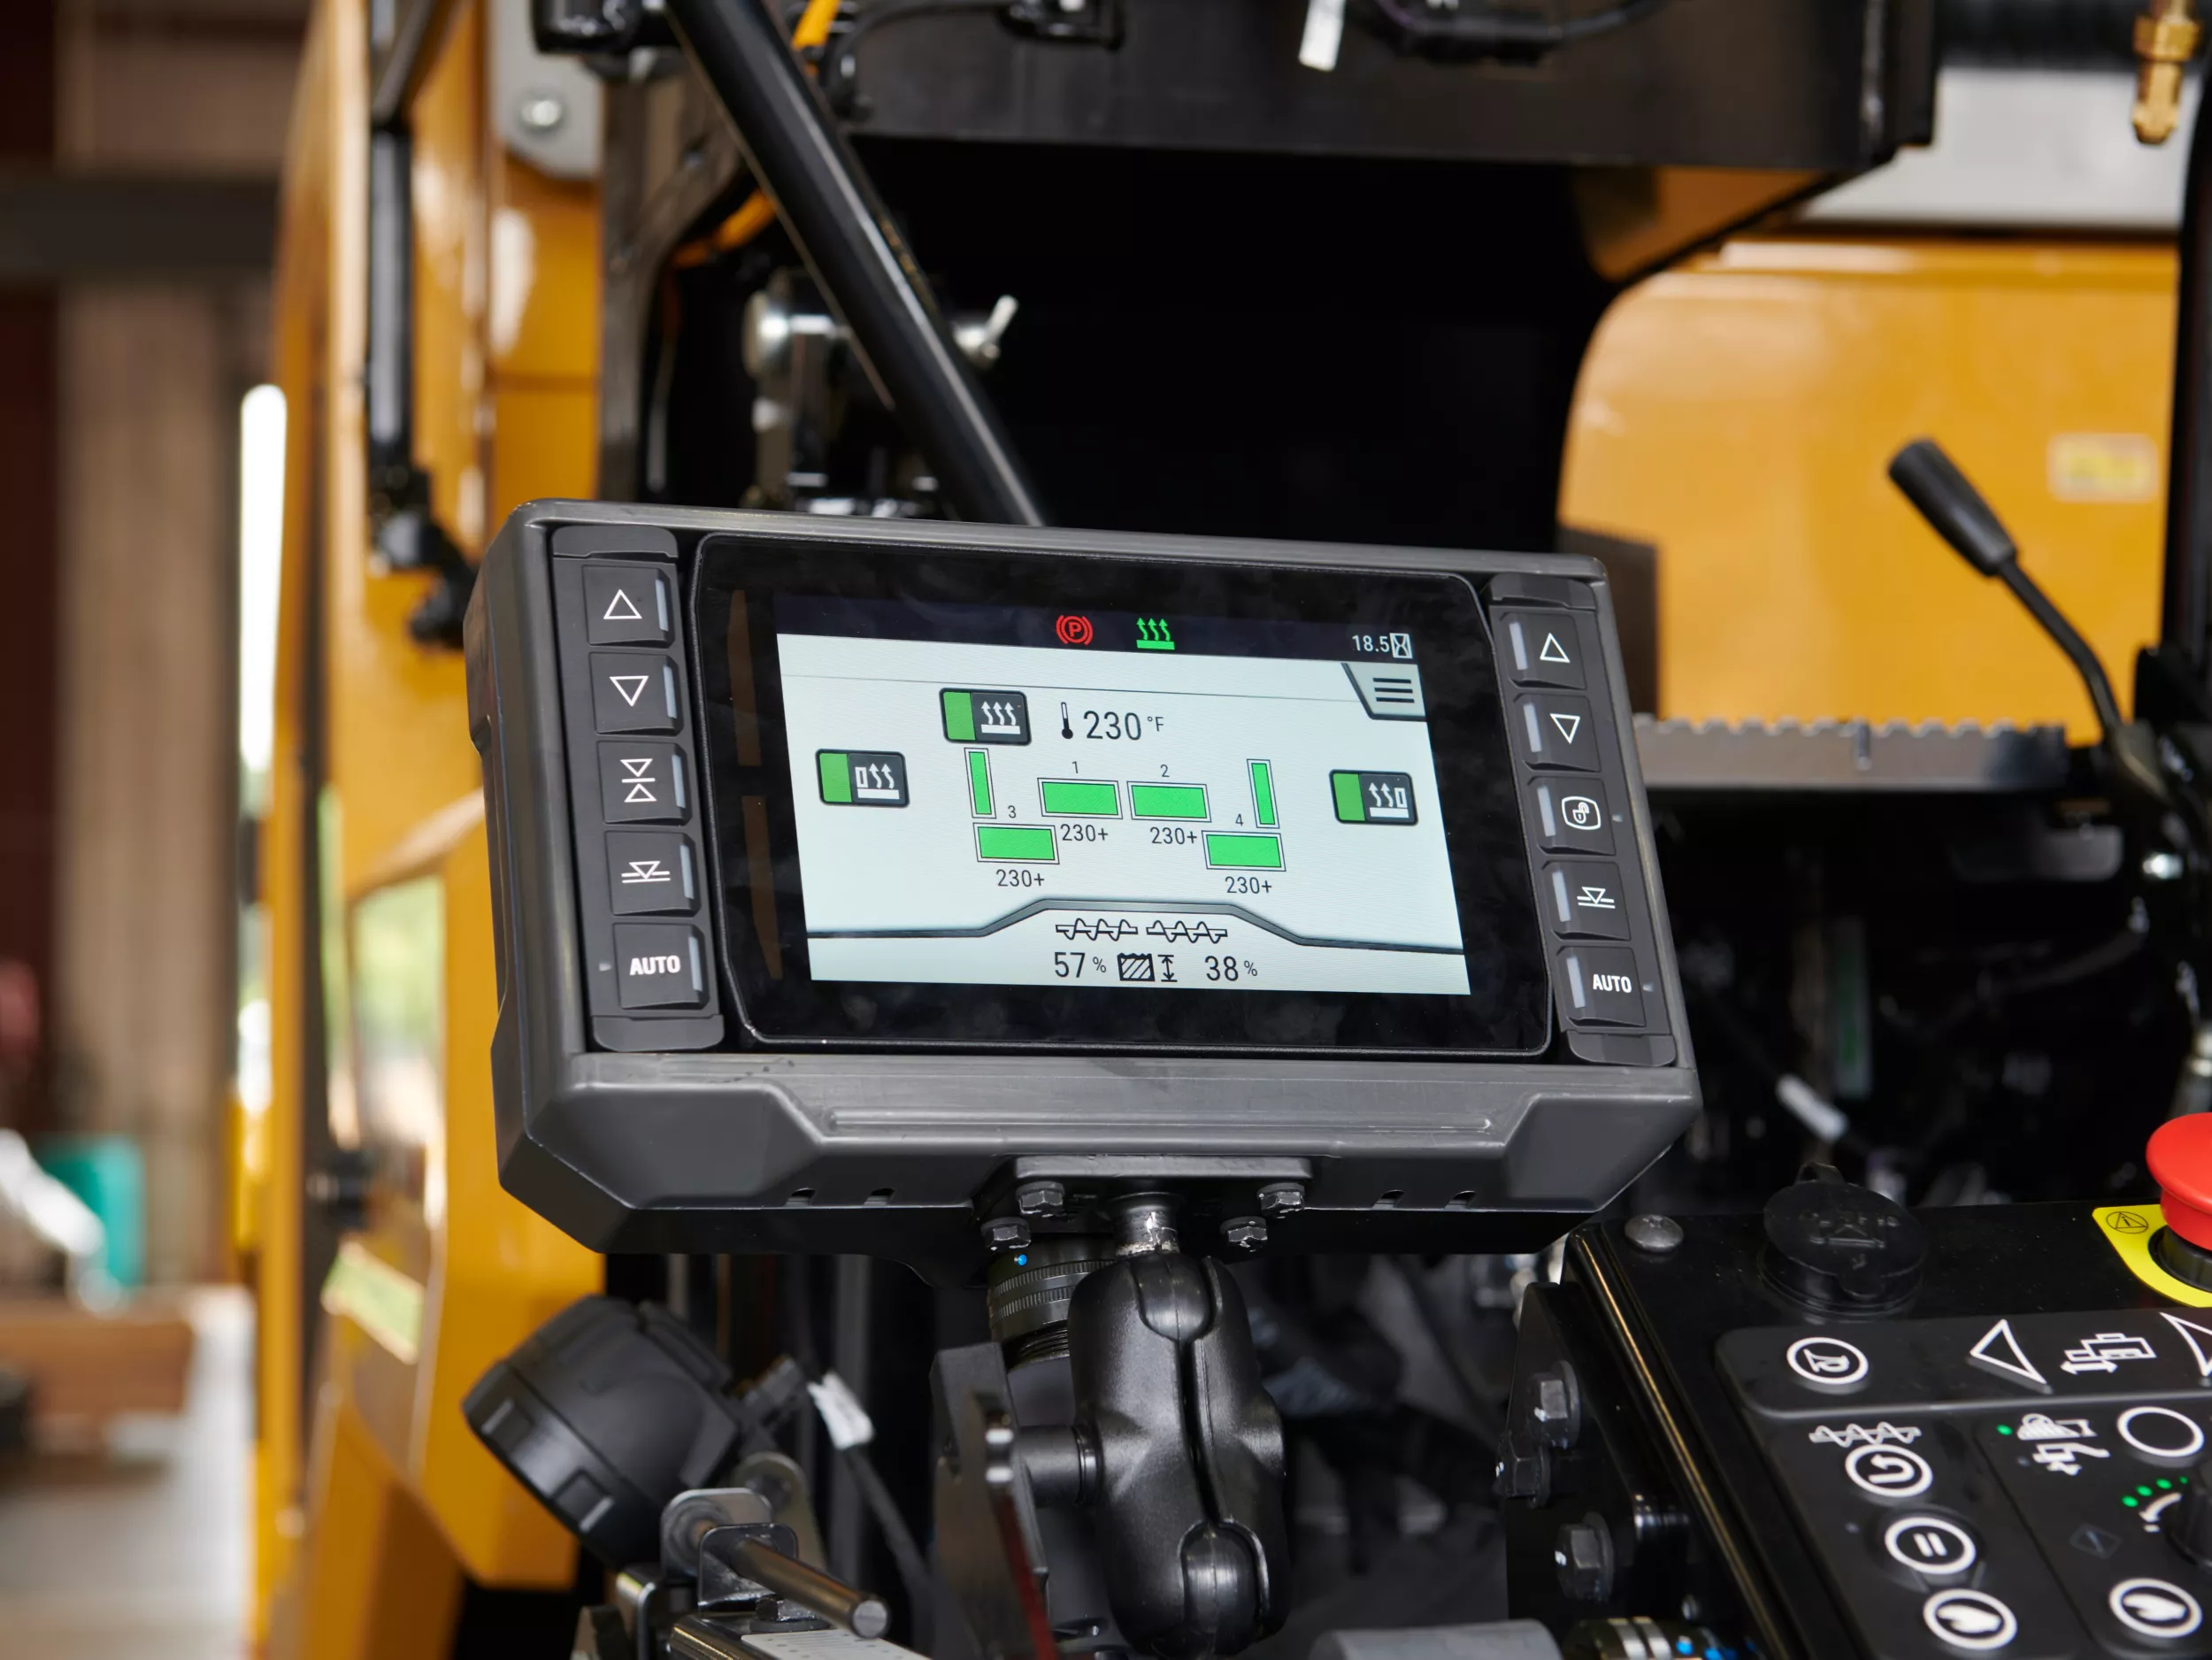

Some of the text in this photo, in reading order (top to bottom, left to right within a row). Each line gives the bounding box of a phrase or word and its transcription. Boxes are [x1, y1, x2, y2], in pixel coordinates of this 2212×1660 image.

[1352, 634, 1390, 653] 18.5
[1083, 710, 1164, 741] 230 °F
[1071, 760, 1079, 774] 1
[1160, 764, 1170, 778] 2
[1007, 804, 1017, 819] 3
[1235, 813, 1244, 826] 4
[1060, 823, 1109, 842] 230+
[1149, 826, 1198, 845] 230+
[995, 869, 1045, 888] 230+
[1225, 876, 1272, 895] 230+
[629, 955, 681, 976] AUTO
[1054, 951, 1107, 979] 57 %
[1204, 956, 1258, 982] 38 %
[1593, 973, 1632, 994] AUTO
